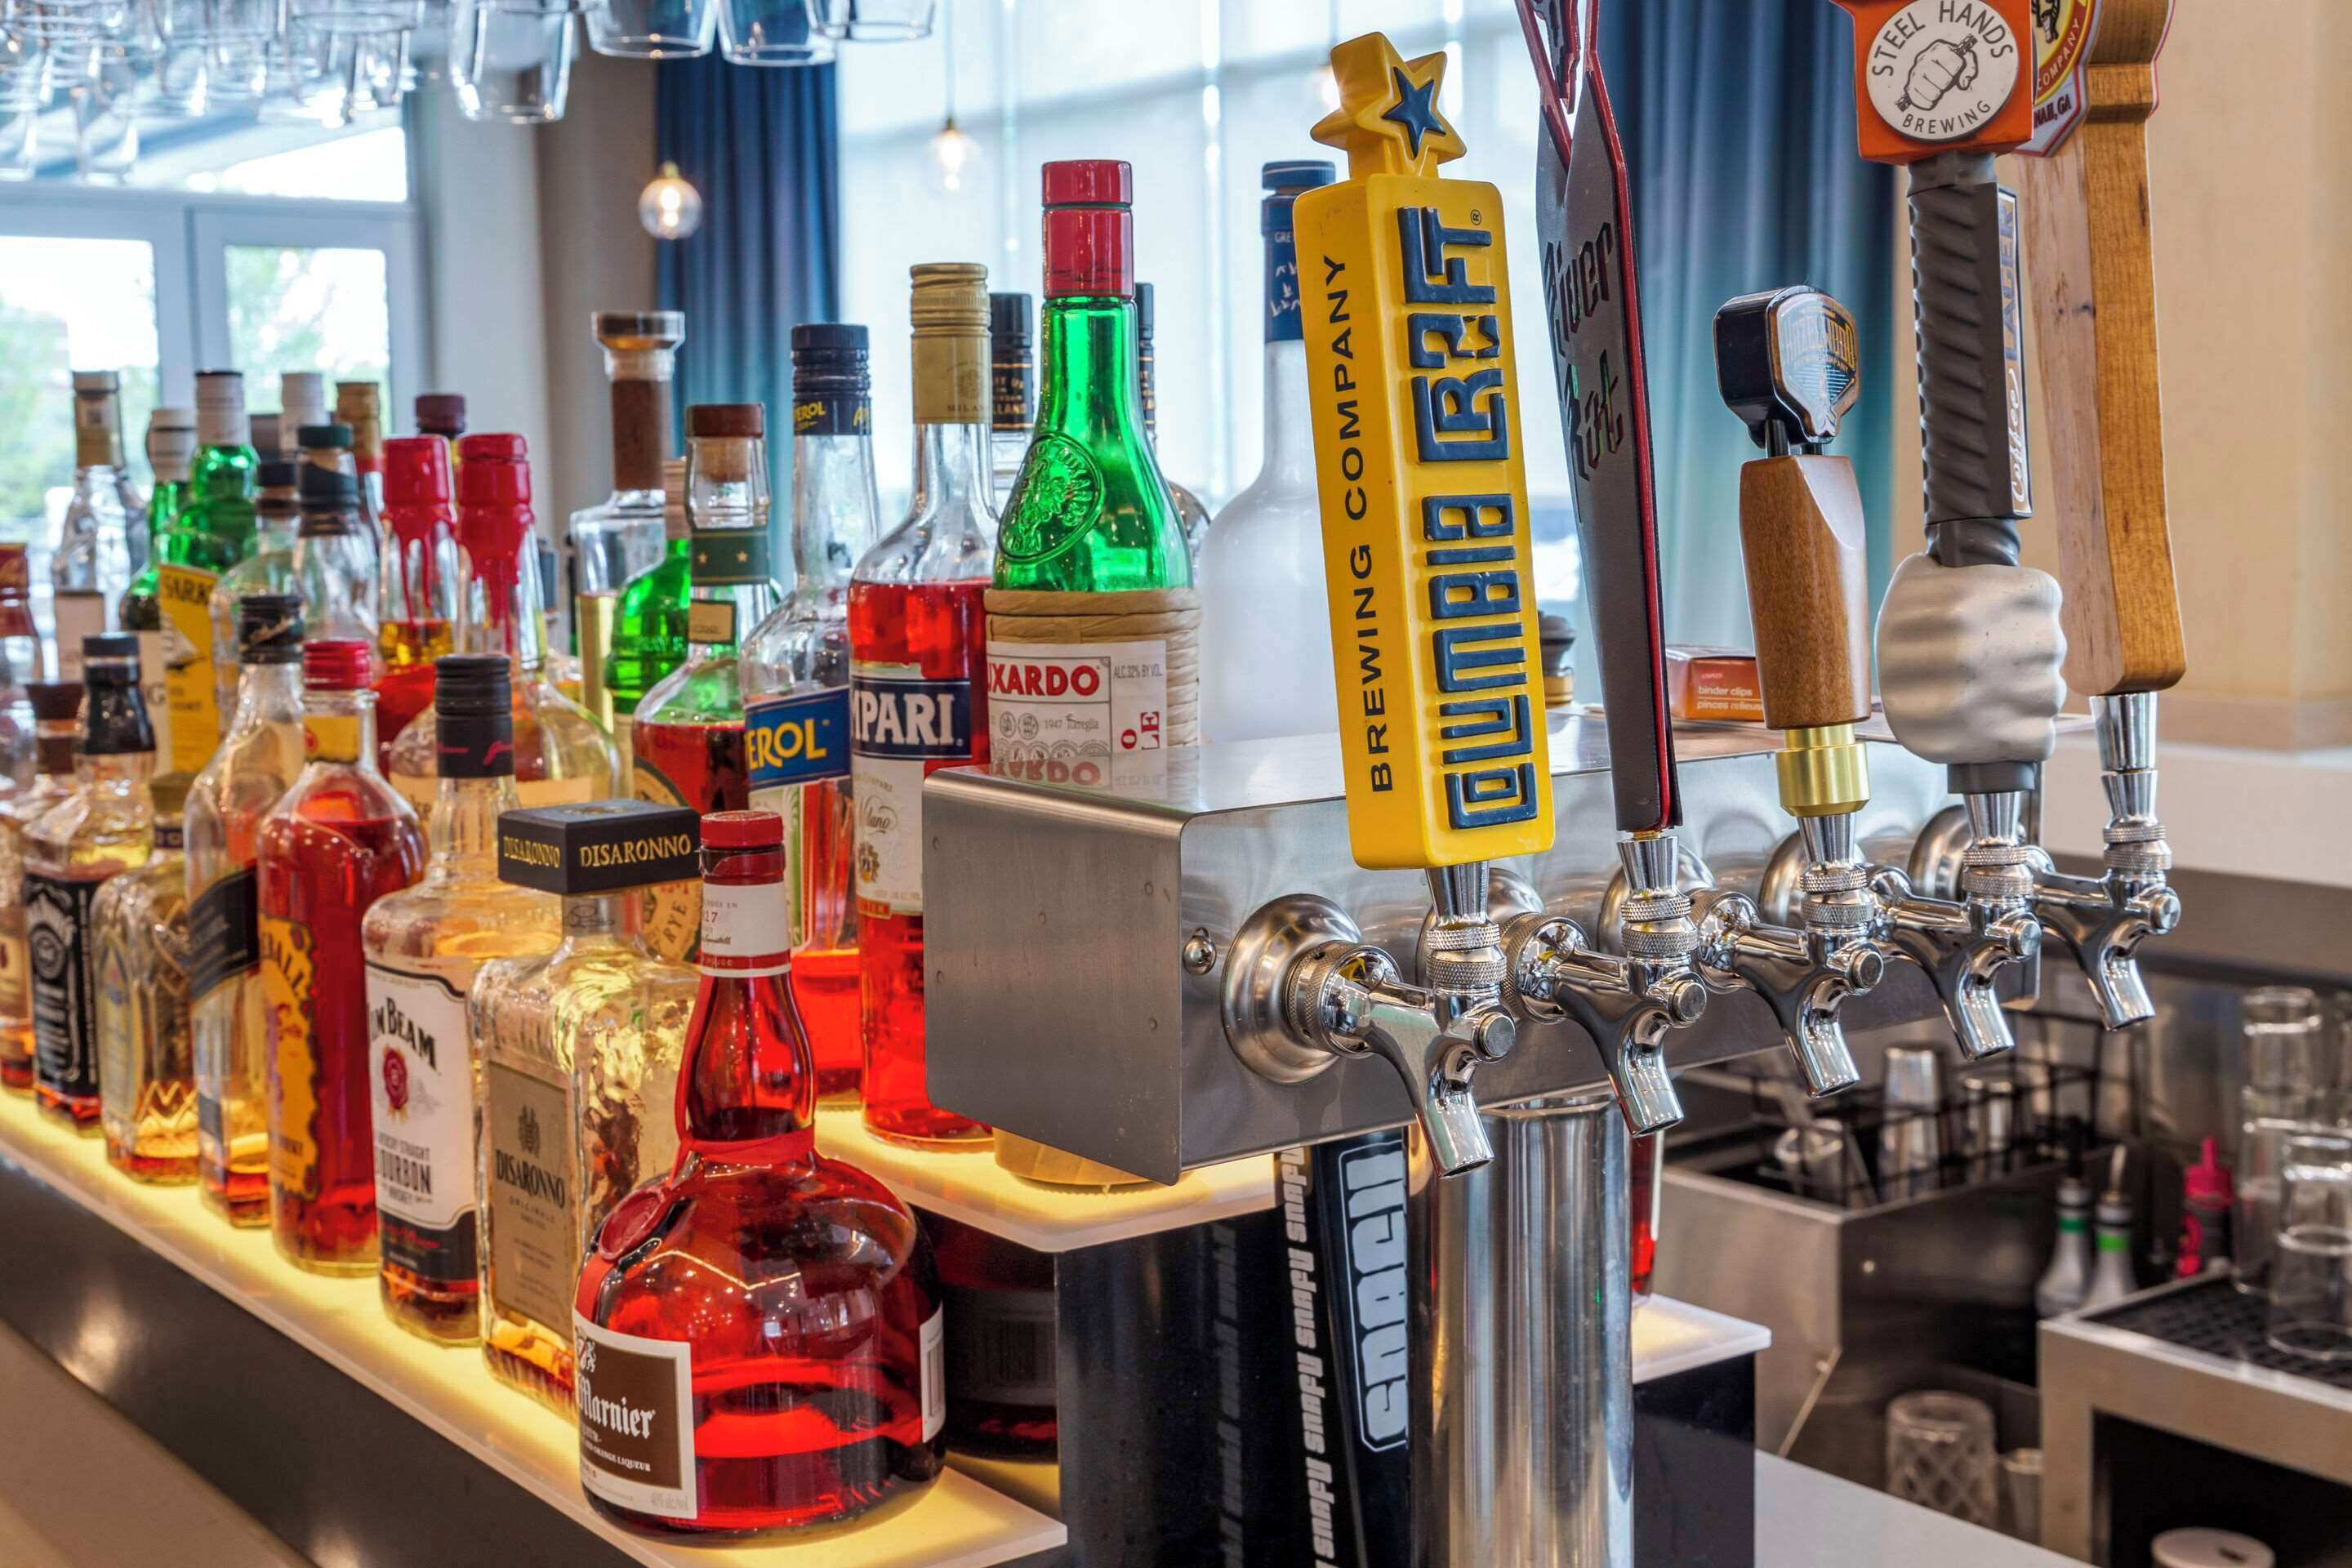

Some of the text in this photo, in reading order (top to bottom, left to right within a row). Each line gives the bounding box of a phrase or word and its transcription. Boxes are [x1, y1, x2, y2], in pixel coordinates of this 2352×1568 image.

[1872, 0, 2013, 76] STEEL HANDS
[1902, 100, 1991, 134] BREWING
[1998, 201, 2019, 362] LAGER
[1397, 206, 1510, 462] CRAFT
[1323, 255, 1364, 521] COMPANY
[2007, 368, 2029, 503] Coffee
[1350, 542, 1394, 793] BREWING
[1423, 493, 1539, 831] COLUMBIA
[1698, 686, 1753, 697] binder clips
[1731, 701, 1762, 710] relieu
[503, 835, 561, 869] DISARONNO
[579, 834, 693, 868] DISARONNO
[386, 996, 437, 1071] BEAM
[495, 1148, 566, 1209] DISARONNO
[577, 1374, 655, 1439] Marnier
